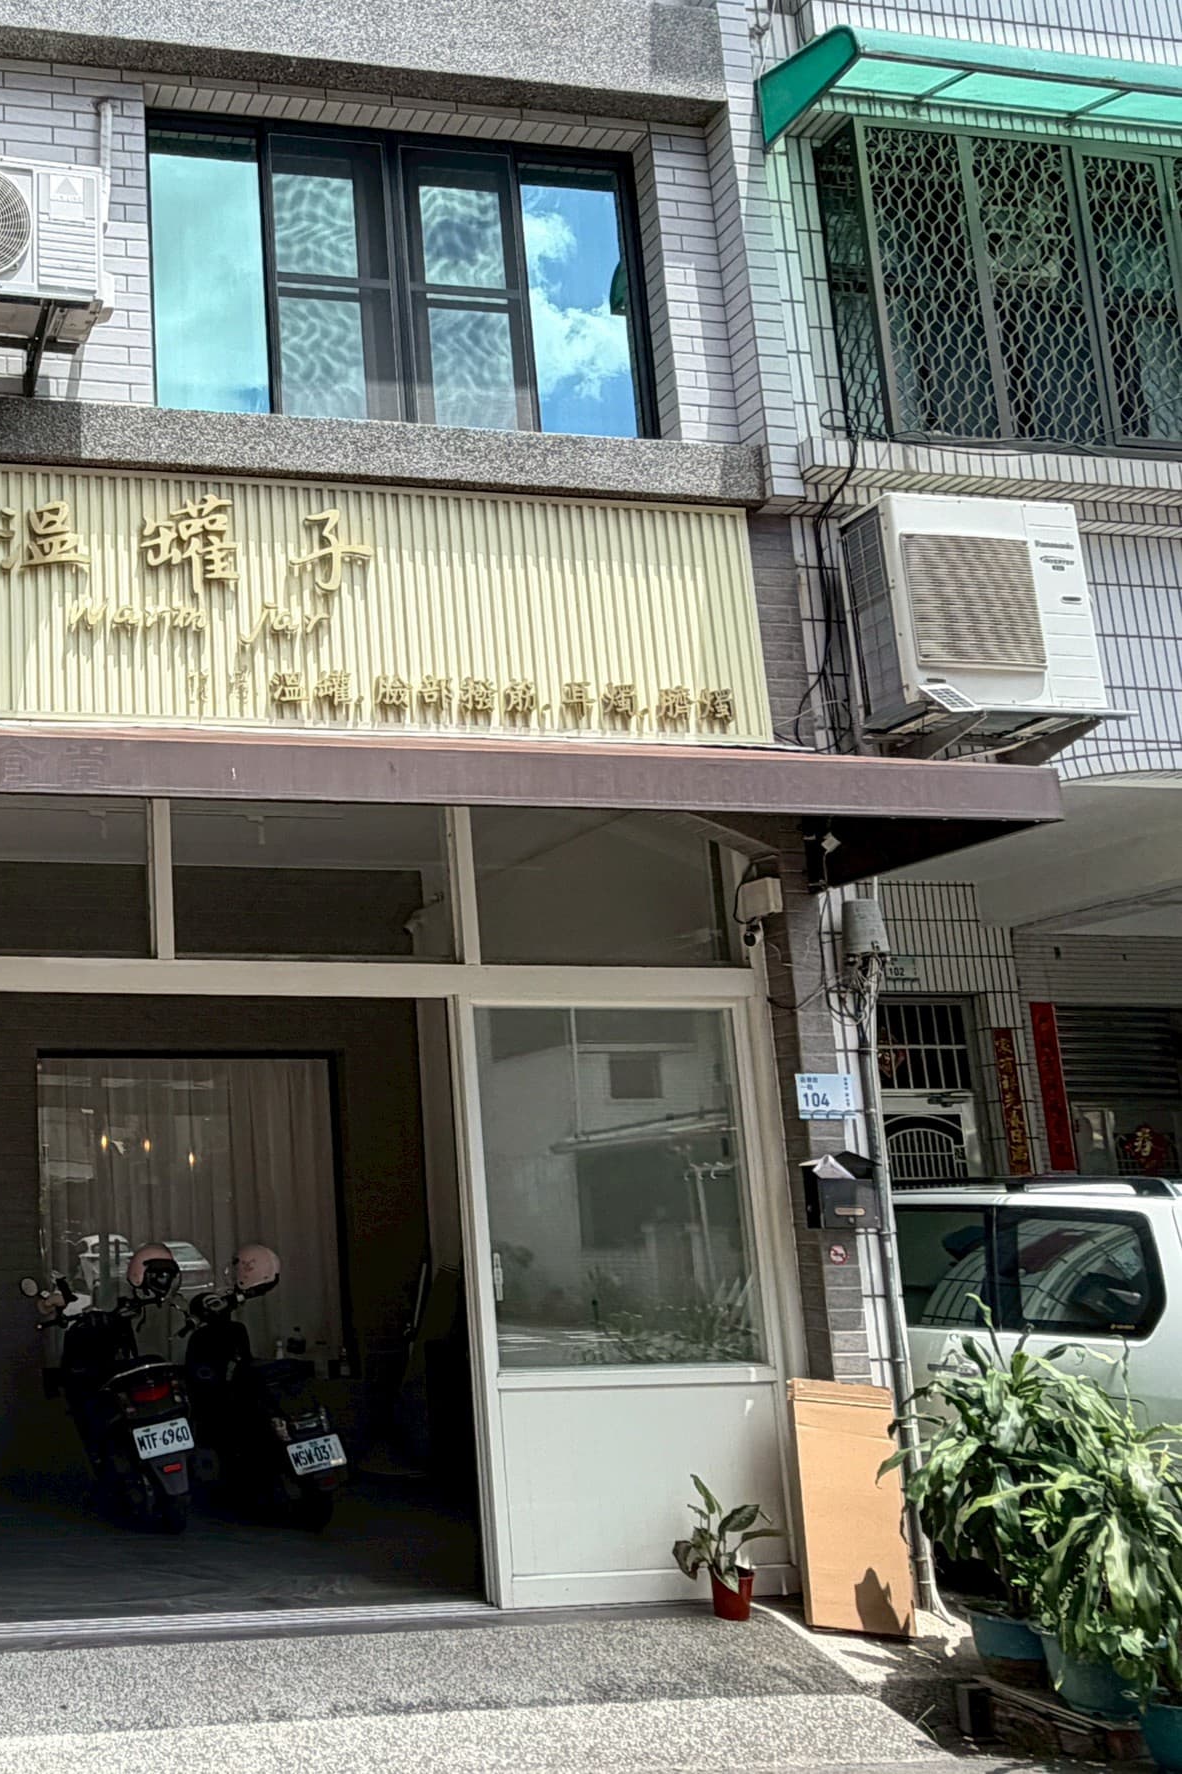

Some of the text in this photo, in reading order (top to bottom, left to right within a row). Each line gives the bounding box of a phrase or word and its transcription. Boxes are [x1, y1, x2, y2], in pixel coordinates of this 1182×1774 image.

[889, 966, 905, 977] 102
[803, 1092, 830, 1107] 104
[137, 1425, 190, 1452] MTF-6960
